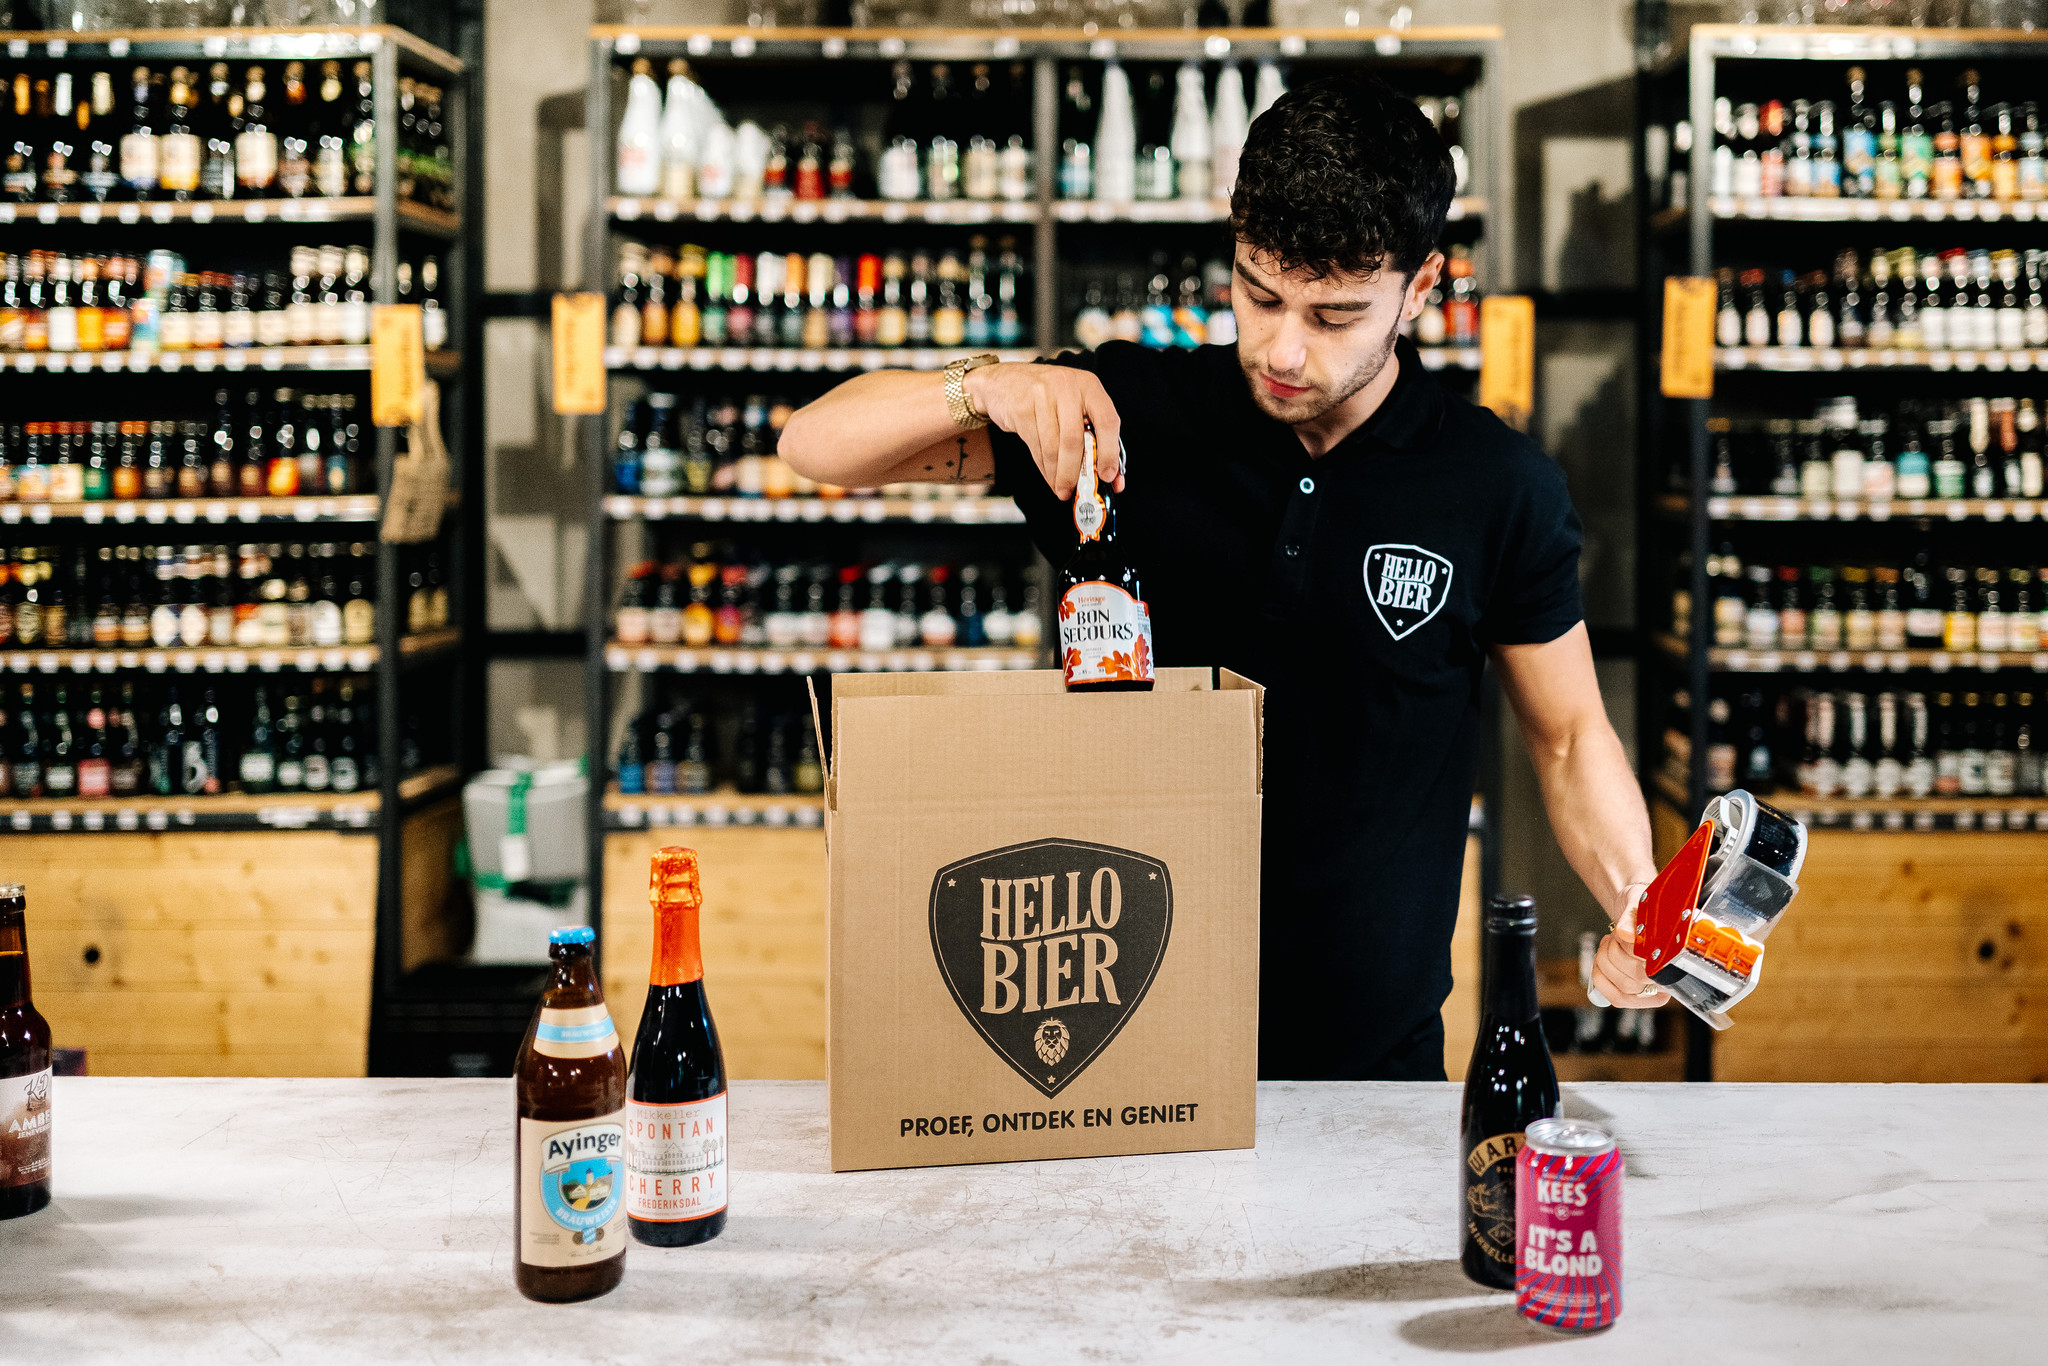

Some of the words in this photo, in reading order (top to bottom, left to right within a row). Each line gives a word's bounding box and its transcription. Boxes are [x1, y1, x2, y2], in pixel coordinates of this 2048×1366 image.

[1381, 553, 1437, 585] HELLO
[1376, 576, 1432, 614] BIER
[1077, 608, 1110, 626] BON
[1063, 623, 1134, 645] SECOURS
[980, 867, 1122, 941] HELLO
[980, 932, 1122, 1015] BIER
[628, 1117, 714, 1140] SPONTAN
[636, 1108, 701, 1121] Mikkeller
[900, 1115, 974, 1138] PROEF,
[982, 1109, 1076, 1133] ONTDEK
[1083, 1108, 1112, 1128] EN
[1120, 1103, 1199, 1126] GENIET
[548, 1130, 622, 1160] Ayinger
[1469, 1136, 1525, 1173] WAR
[629, 1172, 715, 1196] CHERRY
[1537, 1178, 1588, 1207] KEES
[637, 1195, 702, 1210] FREDERIKSDAL
[1528, 1223, 1572, 1253] IT'S
[1579, 1230, 1598, 1253] A
[1524, 1246, 1603, 1277] BLOND
